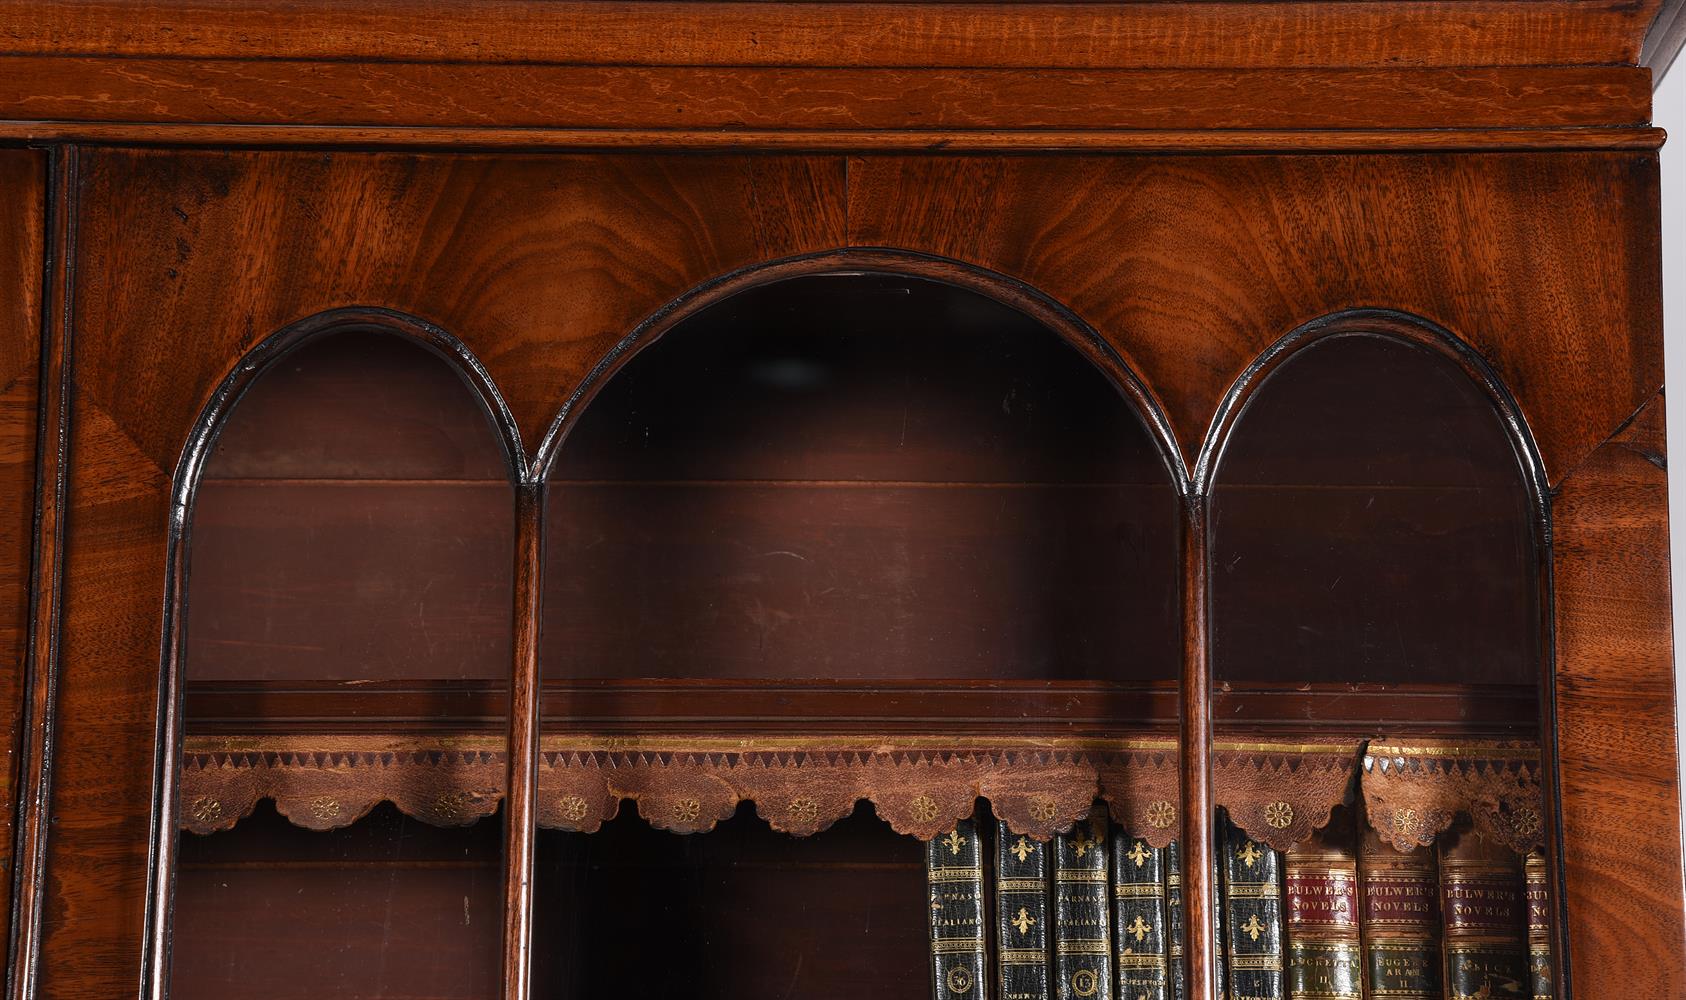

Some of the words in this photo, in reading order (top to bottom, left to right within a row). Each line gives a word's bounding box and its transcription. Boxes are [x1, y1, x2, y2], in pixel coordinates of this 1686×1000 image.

[1287, 885, 1354, 896] BULWER'S
[1367, 886, 1434, 897] BULWER'S
[1292, 901, 1347, 912] NOVELS
[1374, 902, 1429, 912] NOVELS
[1454, 904, 1511, 916] NOVELS
